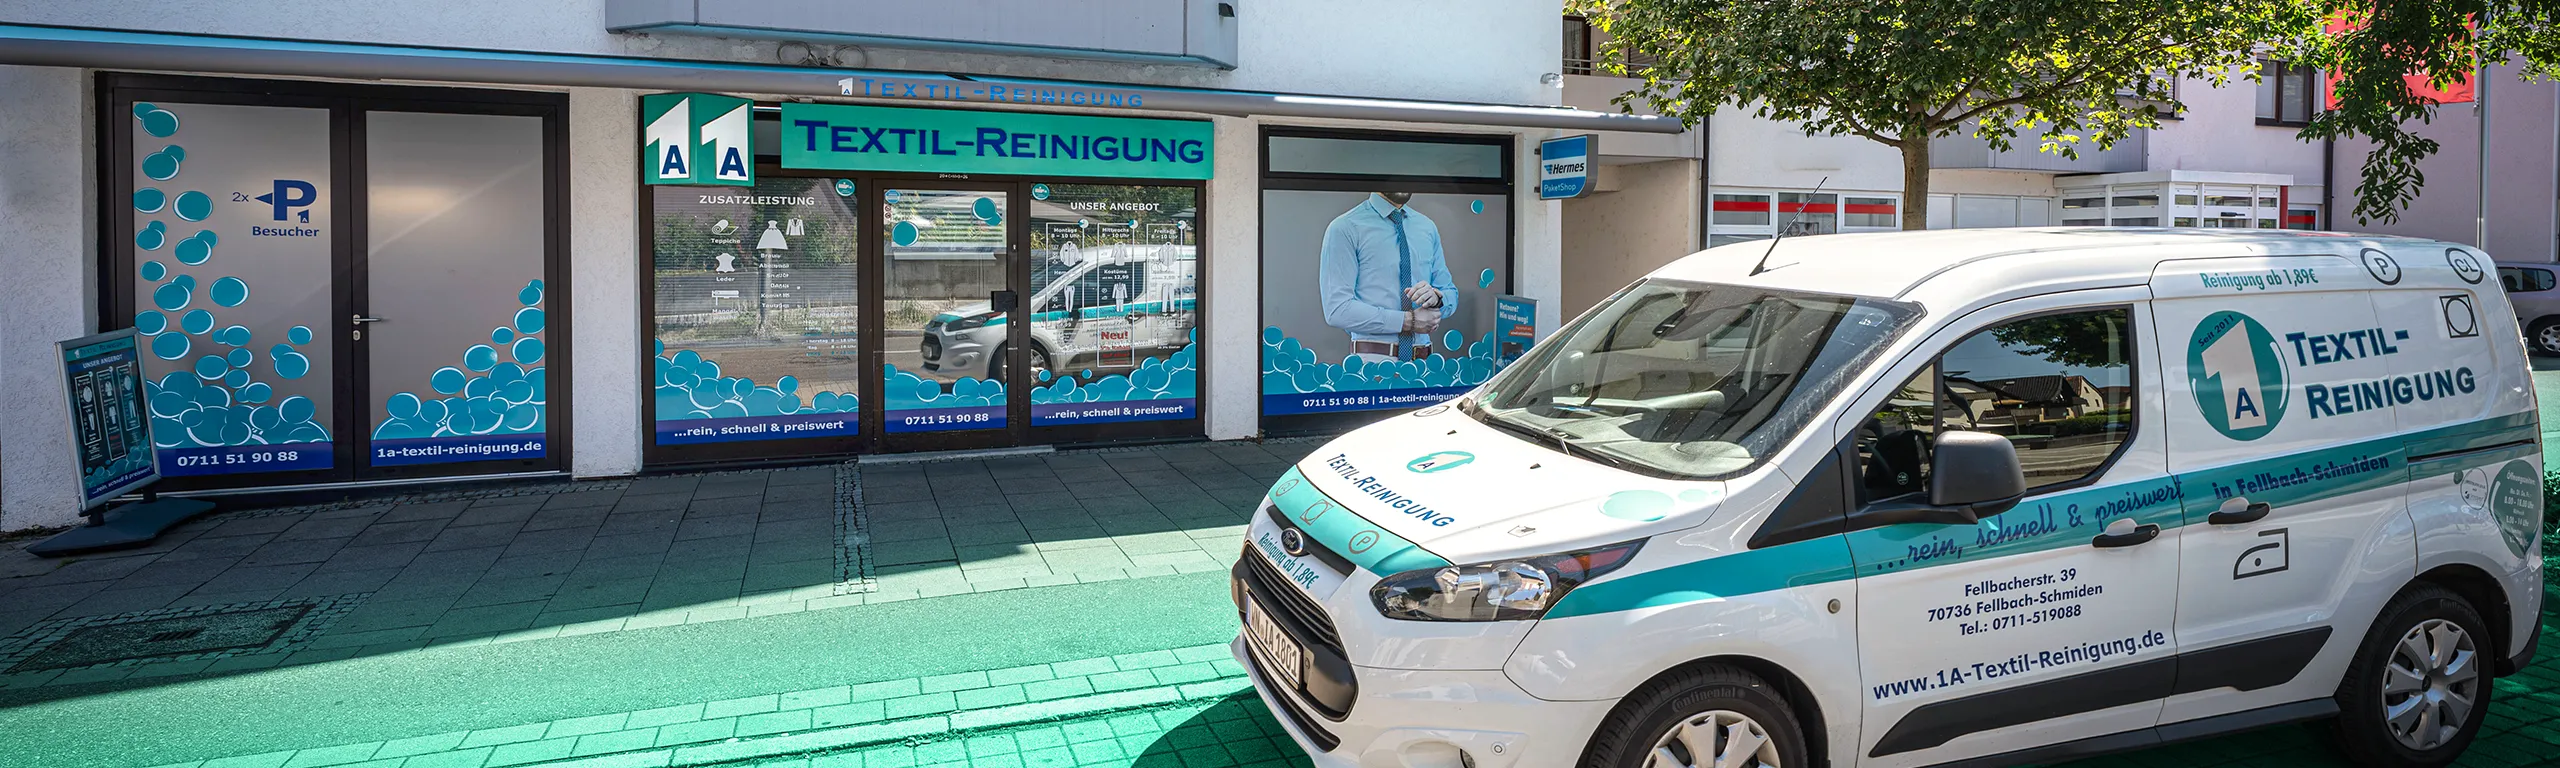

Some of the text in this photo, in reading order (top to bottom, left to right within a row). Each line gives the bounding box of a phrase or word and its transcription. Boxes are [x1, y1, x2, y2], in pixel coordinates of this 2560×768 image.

[794, 119, 1204, 164] TEXTIL-REINIGUNG
[1552, 162, 1584, 174] Hermes
[232, 191, 250, 202] 2x
[1544, 182, 1576, 192] PaketShop
[699, 195, 815, 206] ZUSATZLEISTUNG
[1070, 202, 1159, 211] UNSER ANGEBOT
[252, 226, 320, 237] Besucher
[2200, 268, 2319, 291] Reinigung ab 1,89€
[1100, 331, 1128, 340] Neu!
[2197, 314, 2234, 347] Seit 2011
[2285, 327, 2410, 367] TEXTIL-
[83, 354, 123, 369] UNSER ANGEBOT
[1303, 398, 1326, 407] 0711
[1329, 398, 1340, 406] 51
[1343, 397, 1355, 405] 90
[1357, 396, 1369, 404] 88
[2305, 366, 2476, 420] REINIGUNG
[905, 413, 989, 426] 0711 51 90 88
[1044, 405, 1183, 420] ...rein, schnell & preiswert
[674, 420, 844, 437] ...rein, schnell & preiswert
[177, 451, 298, 466] 0711 51 90 88
[377, 442, 542, 458] 1a-textil-reinigung.de
[2211, 455, 2389, 500] in Fellbach-Schmiden
[1876, 475, 2185, 570] ...rein, schnell & preiswert
[1258, 532, 1320, 590] Reinigung ab 1,89€
[1964, 568, 2077, 596] Fellbacherstr. 39
[1928, 583, 2103, 622] 70736 Fellbach-Schmiden
[1960, 604, 2082, 636] Tel.: 0711-519088
[1275, 632, 1297, 678] 1801
[1873, 629, 2165, 700] www.1A-Textil-Reinigung.de
[1672, 687, 1736, 713] Continental
